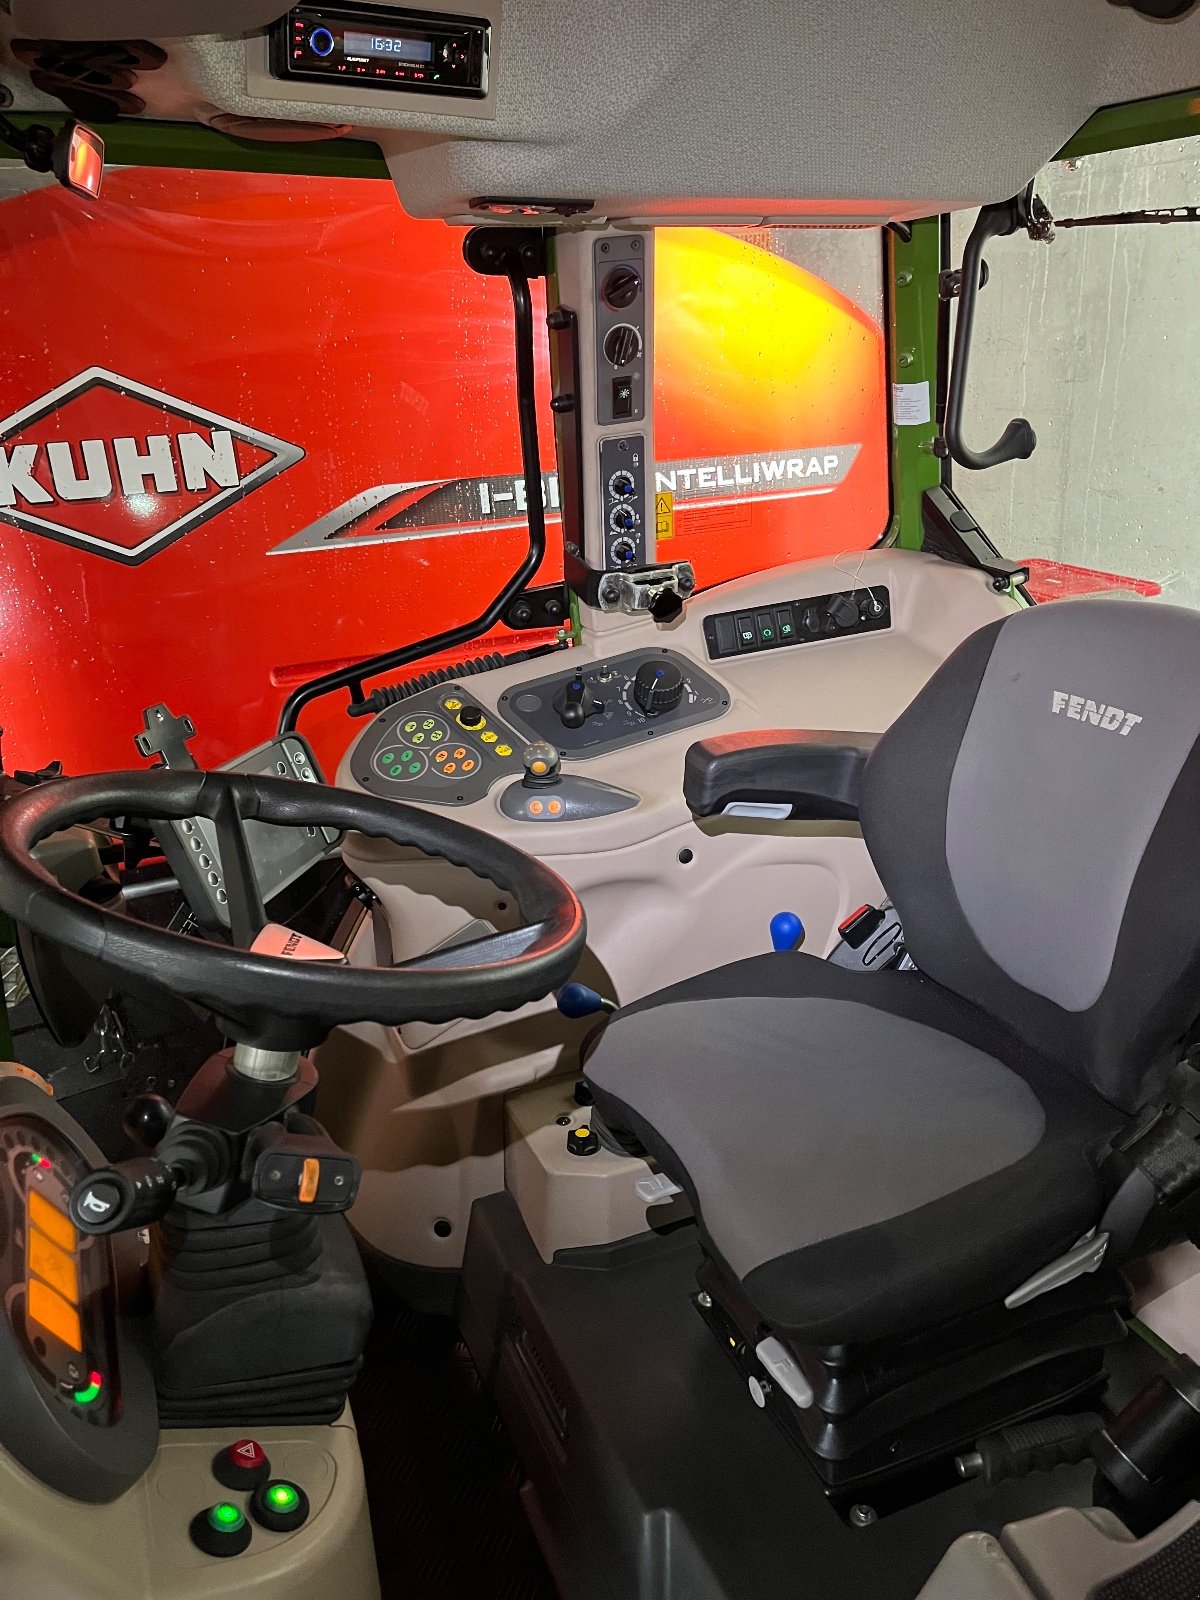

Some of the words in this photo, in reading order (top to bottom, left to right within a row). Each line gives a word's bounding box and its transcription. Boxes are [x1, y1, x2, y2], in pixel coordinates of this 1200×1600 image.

[371, 37, 402, 52] 16:32
[0, 430, 240, 507] KUHN
[1051, 690, 1143, 736] FENDT
